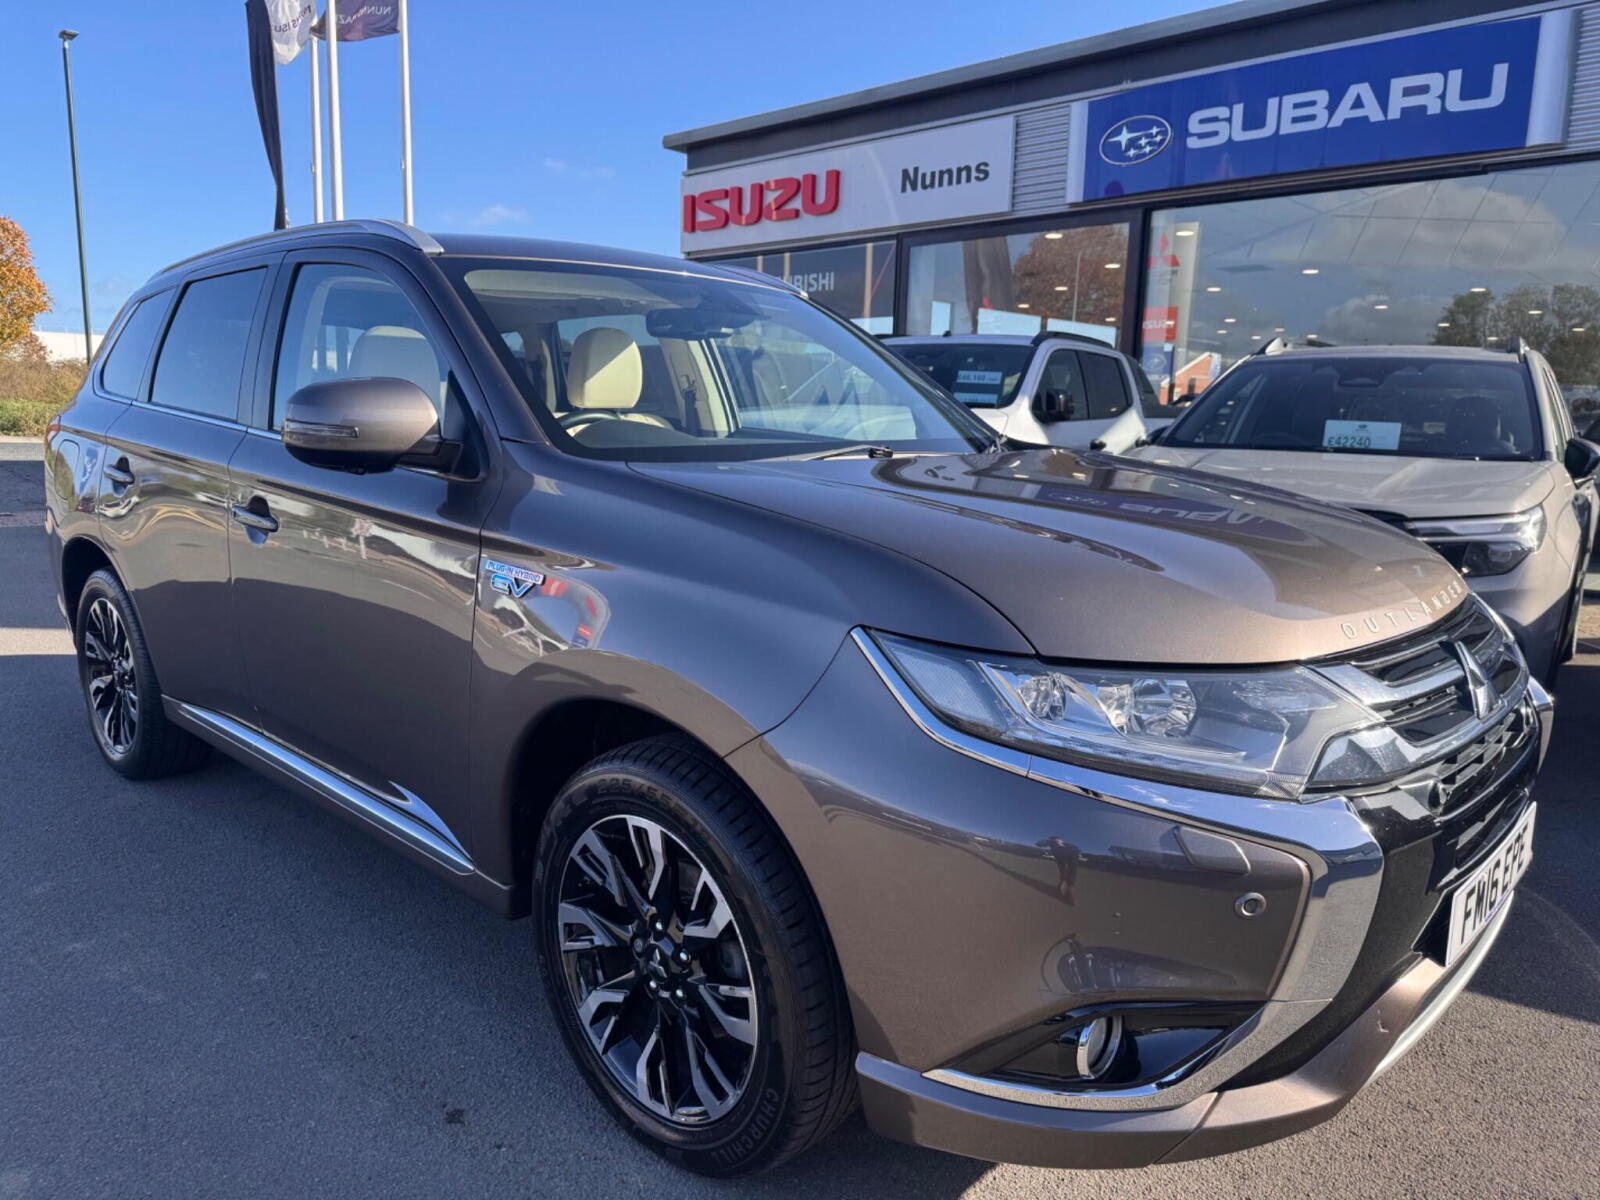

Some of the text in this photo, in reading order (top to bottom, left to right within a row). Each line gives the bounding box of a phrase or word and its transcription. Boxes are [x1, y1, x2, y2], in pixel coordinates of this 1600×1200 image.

[1186, 63, 1510, 150] SUBARU
[683, 169, 841, 233] ISUZU
[900, 161, 990, 193] Nunns
[491, 573, 533, 598] EV
[1340, 580, 1464, 640] OUTLANDER
[1461, 857, 1501, 945] FM16
[1501, 821, 1529, 894] EPE
